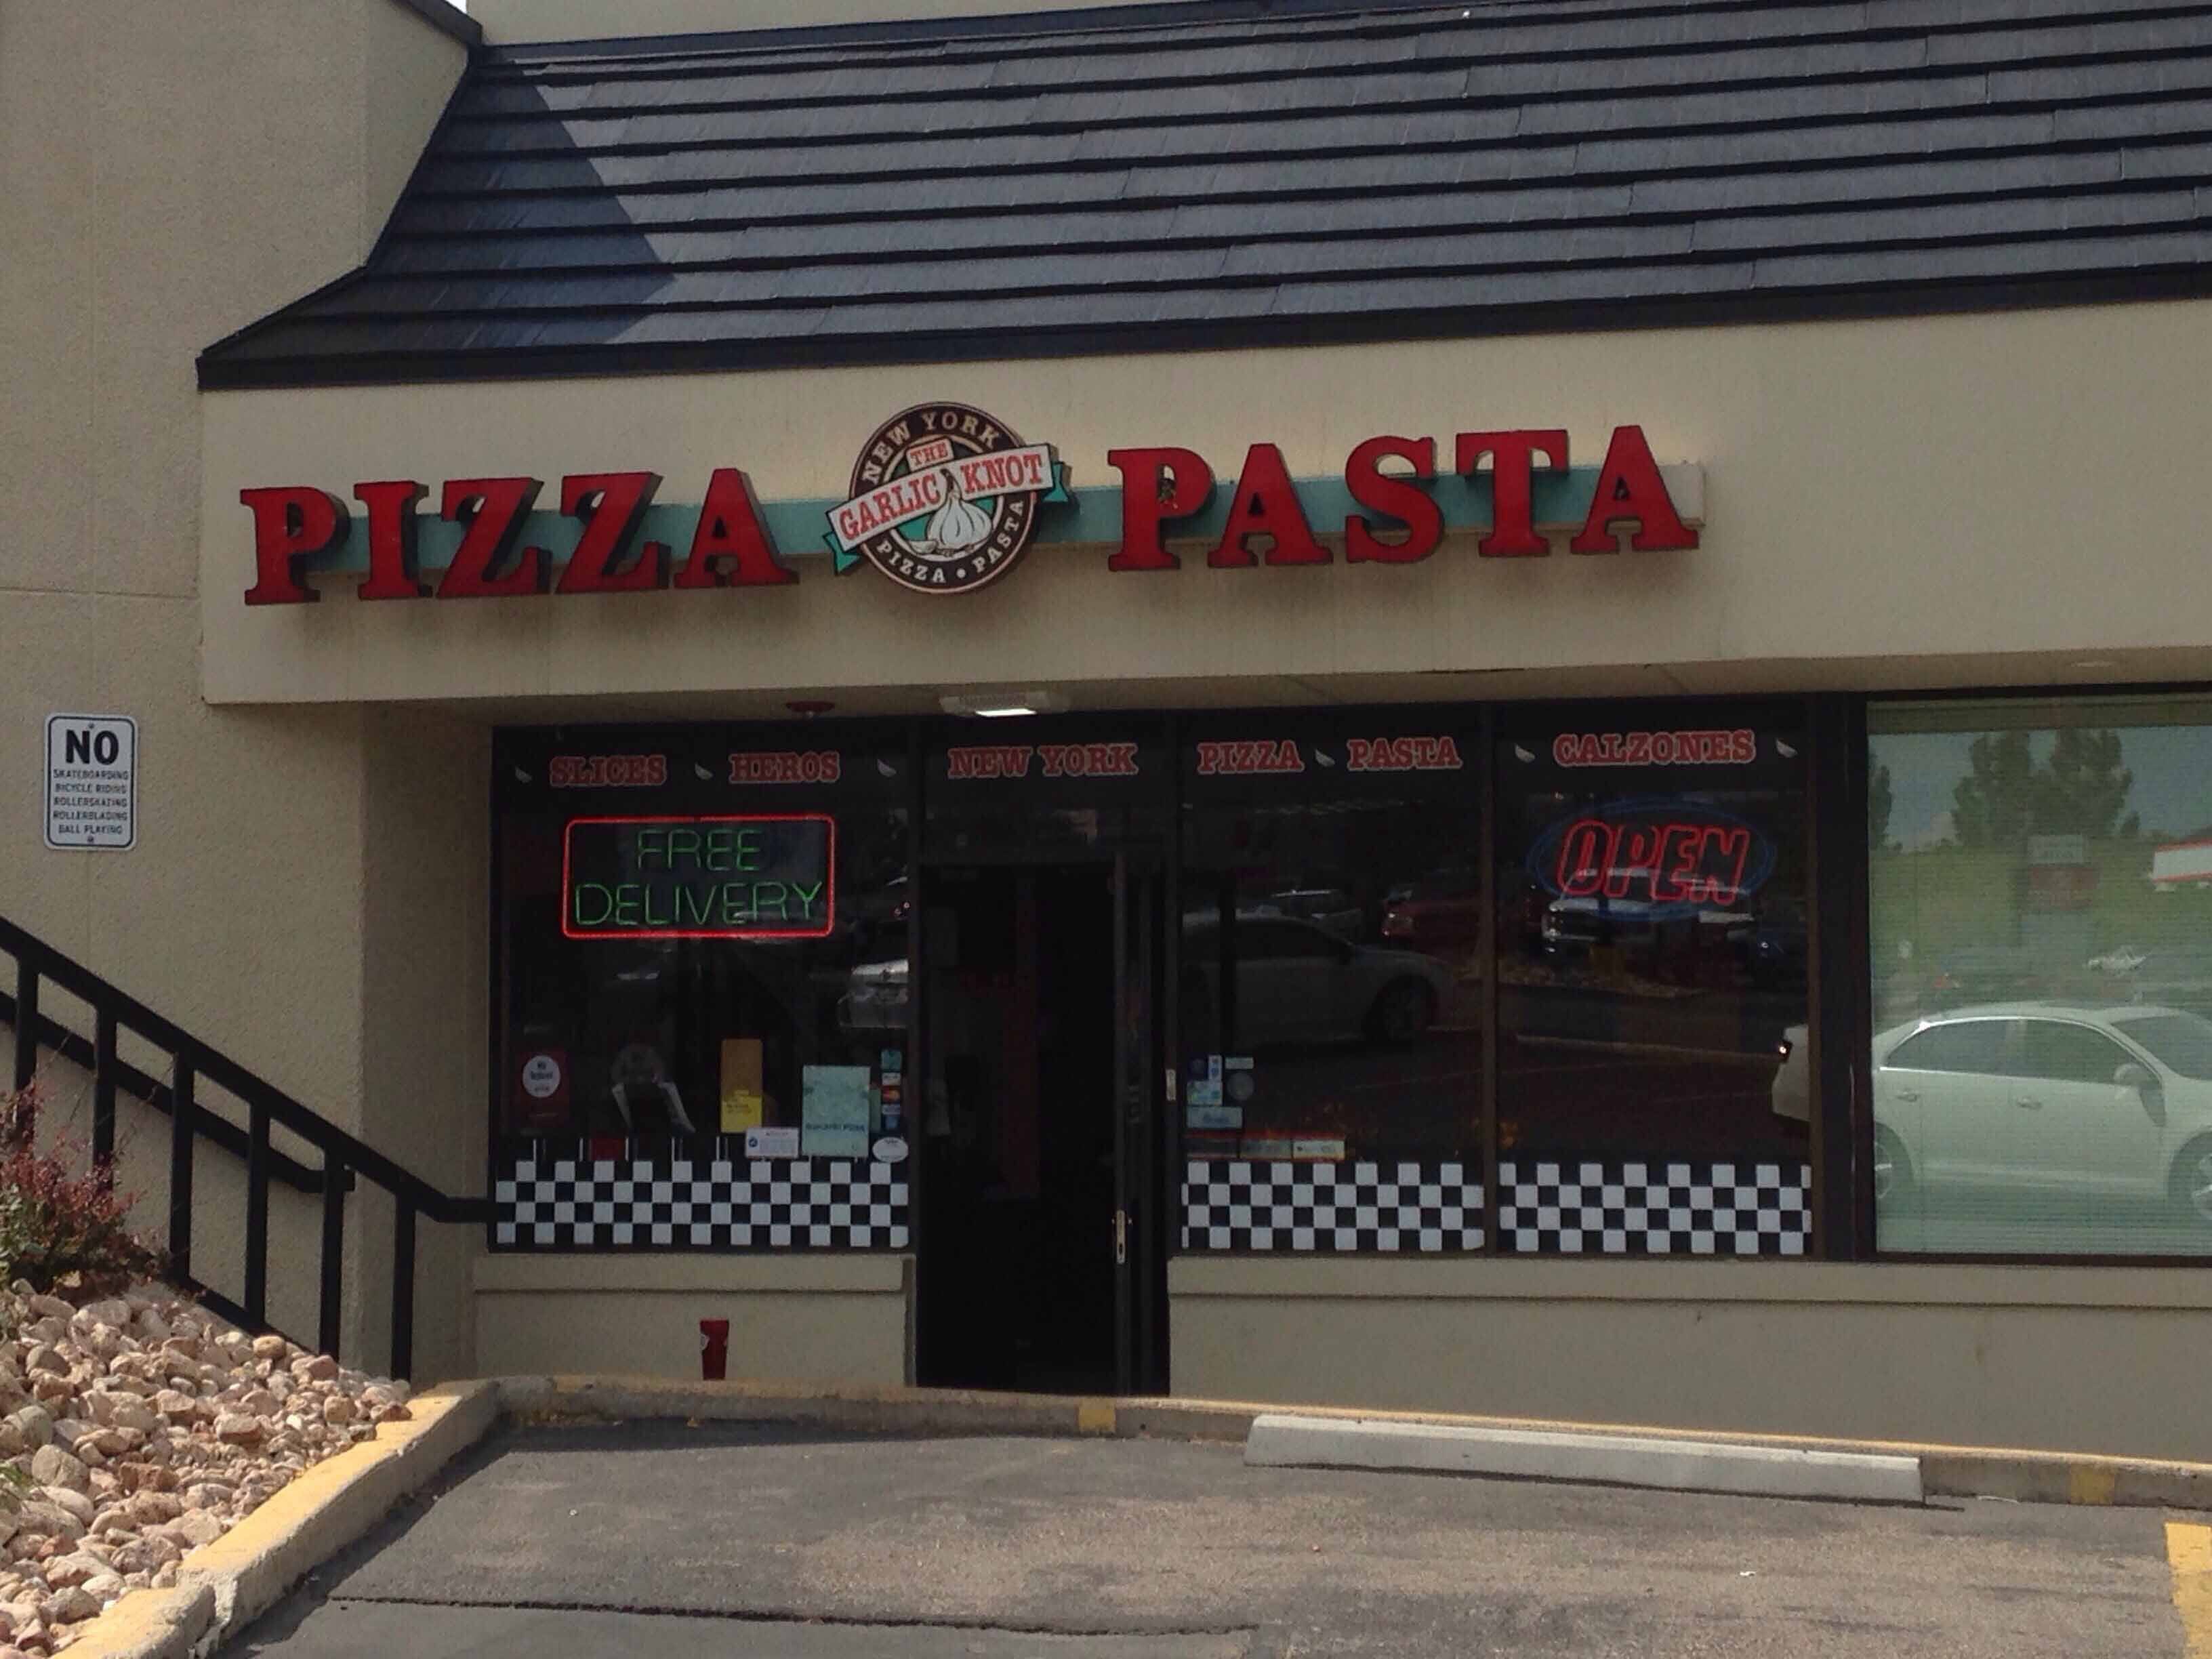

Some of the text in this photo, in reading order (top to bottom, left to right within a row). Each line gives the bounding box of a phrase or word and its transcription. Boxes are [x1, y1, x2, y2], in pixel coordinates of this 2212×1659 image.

[862, 411, 1001, 485] NEW YORK
[909, 443, 949, 468] THE
[839, 453, 1044, 541] GARLIC KNOT
[1107, 424, 1700, 571] PASTA
[240, 468, 800, 605] PIZZA
[876, 500, 1025, 584] PIZZA PASTA
[65, 729, 119, 765] NO
[948, 743, 1139, 779] NEW YORK
[1197, 737, 1463, 774] PIZZA PASTA
[1553, 729, 1757, 767] CALZONES
[54, 769, 129, 780] SKATEBOARDING
[550, 751, 840, 786] SLICES HEROS
[54, 796, 127, 807] ROLLERSKATING
[55, 783, 93, 794] BICYCLE
[54, 811, 128, 821] ROLLERBLADING
[58, 824, 123, 835] BALL PLAYING
[637, 828, 764, 872] FREE
[1557, 818, 1751, 906] OPEN
[574, 881, 824, 926] DELIVERY
